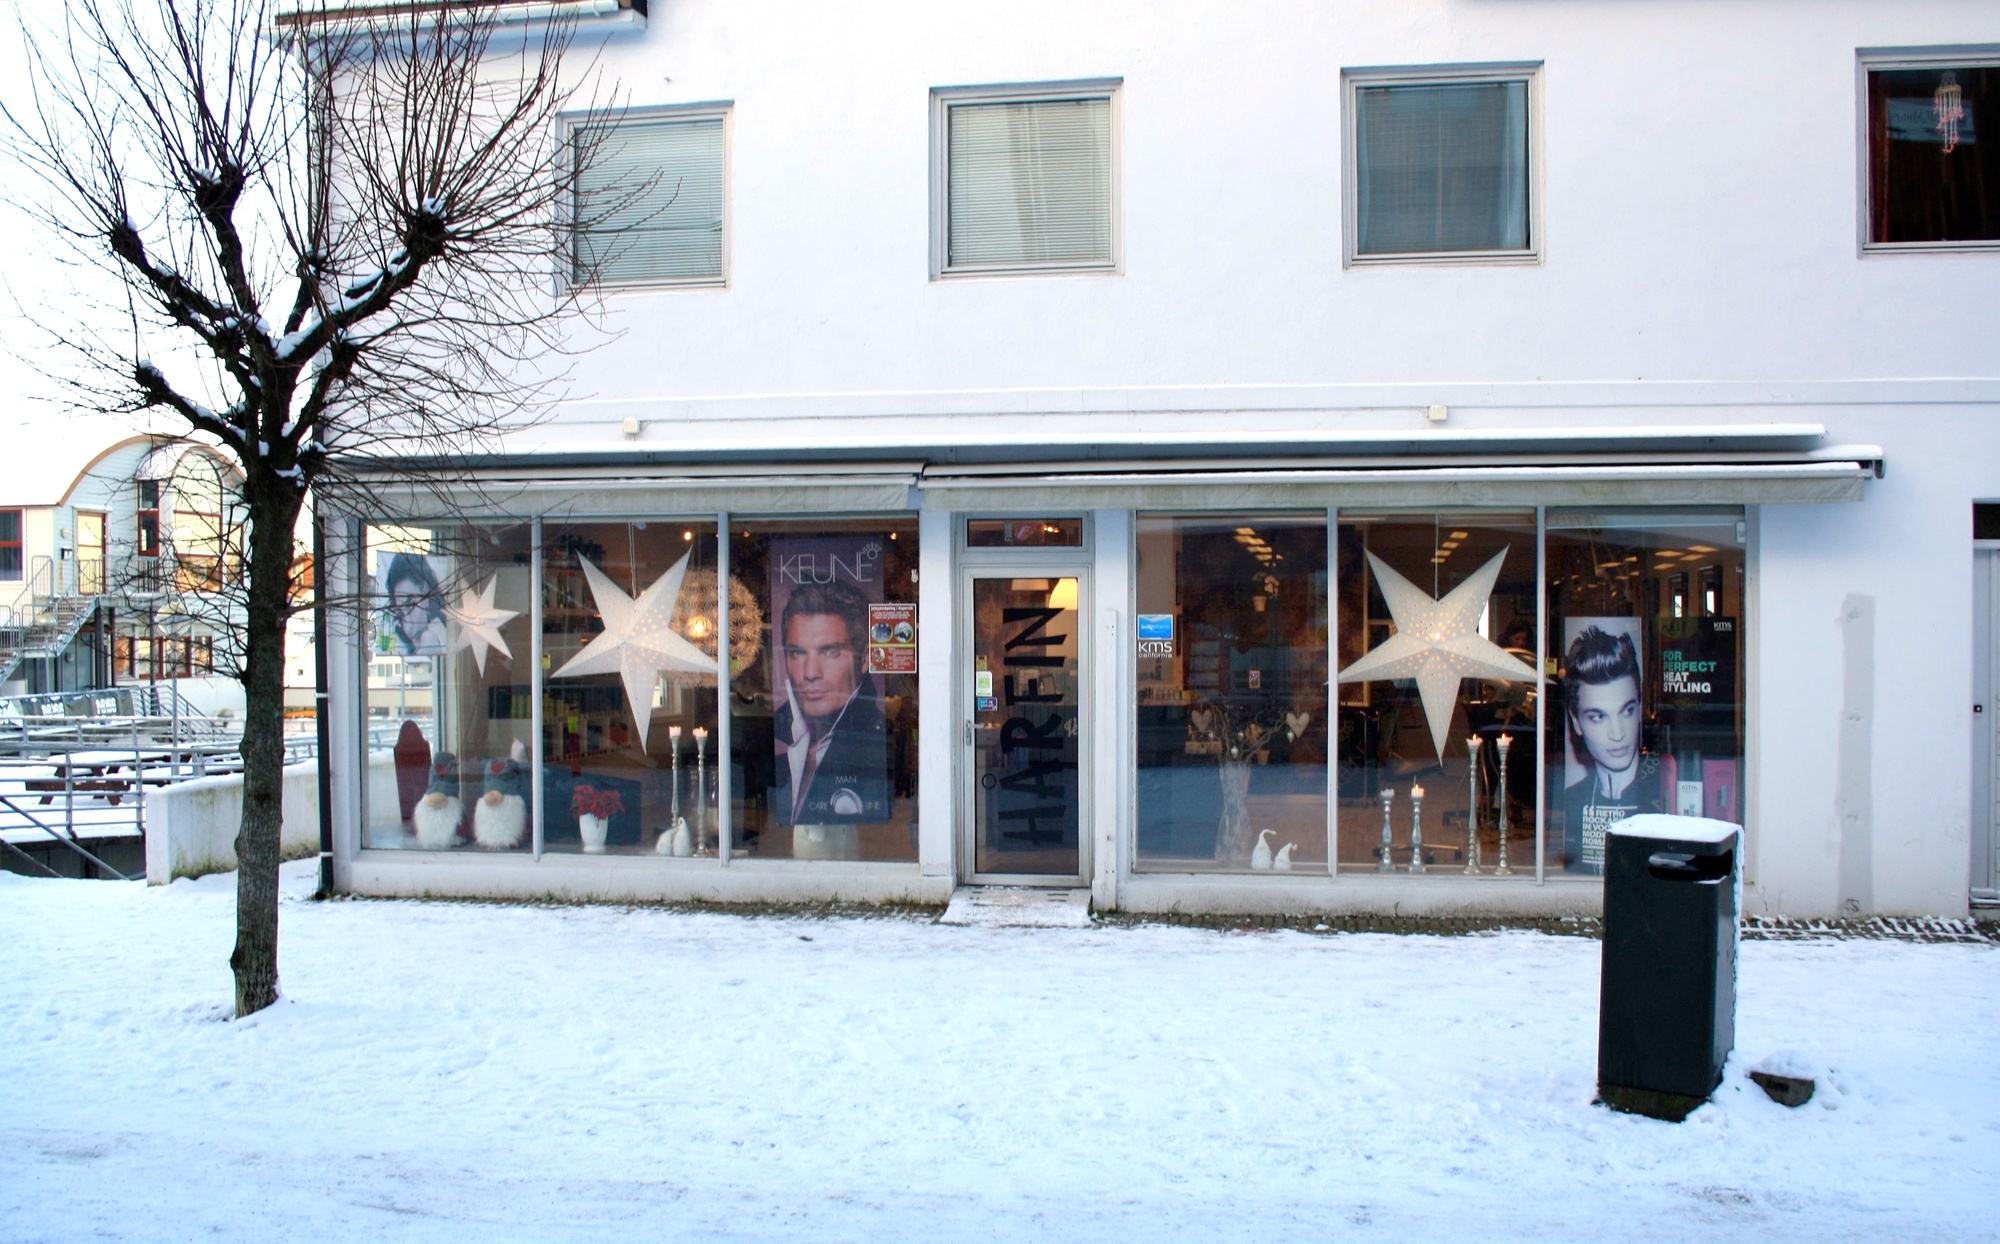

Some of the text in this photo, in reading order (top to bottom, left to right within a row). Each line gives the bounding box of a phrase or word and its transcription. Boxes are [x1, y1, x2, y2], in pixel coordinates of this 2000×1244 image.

[780, 552, 873, 585] KEUNE
[1663, 650, 1682, 661] FOR
[1663, 661, 1717, 673] PERFECT
[1663, 672, 1690, 682] HEAT
[1663, 682, 1712, 693] STYLING
[835, 775, 857, 784] MAN
[1582, 823, 1592, 831] IN
